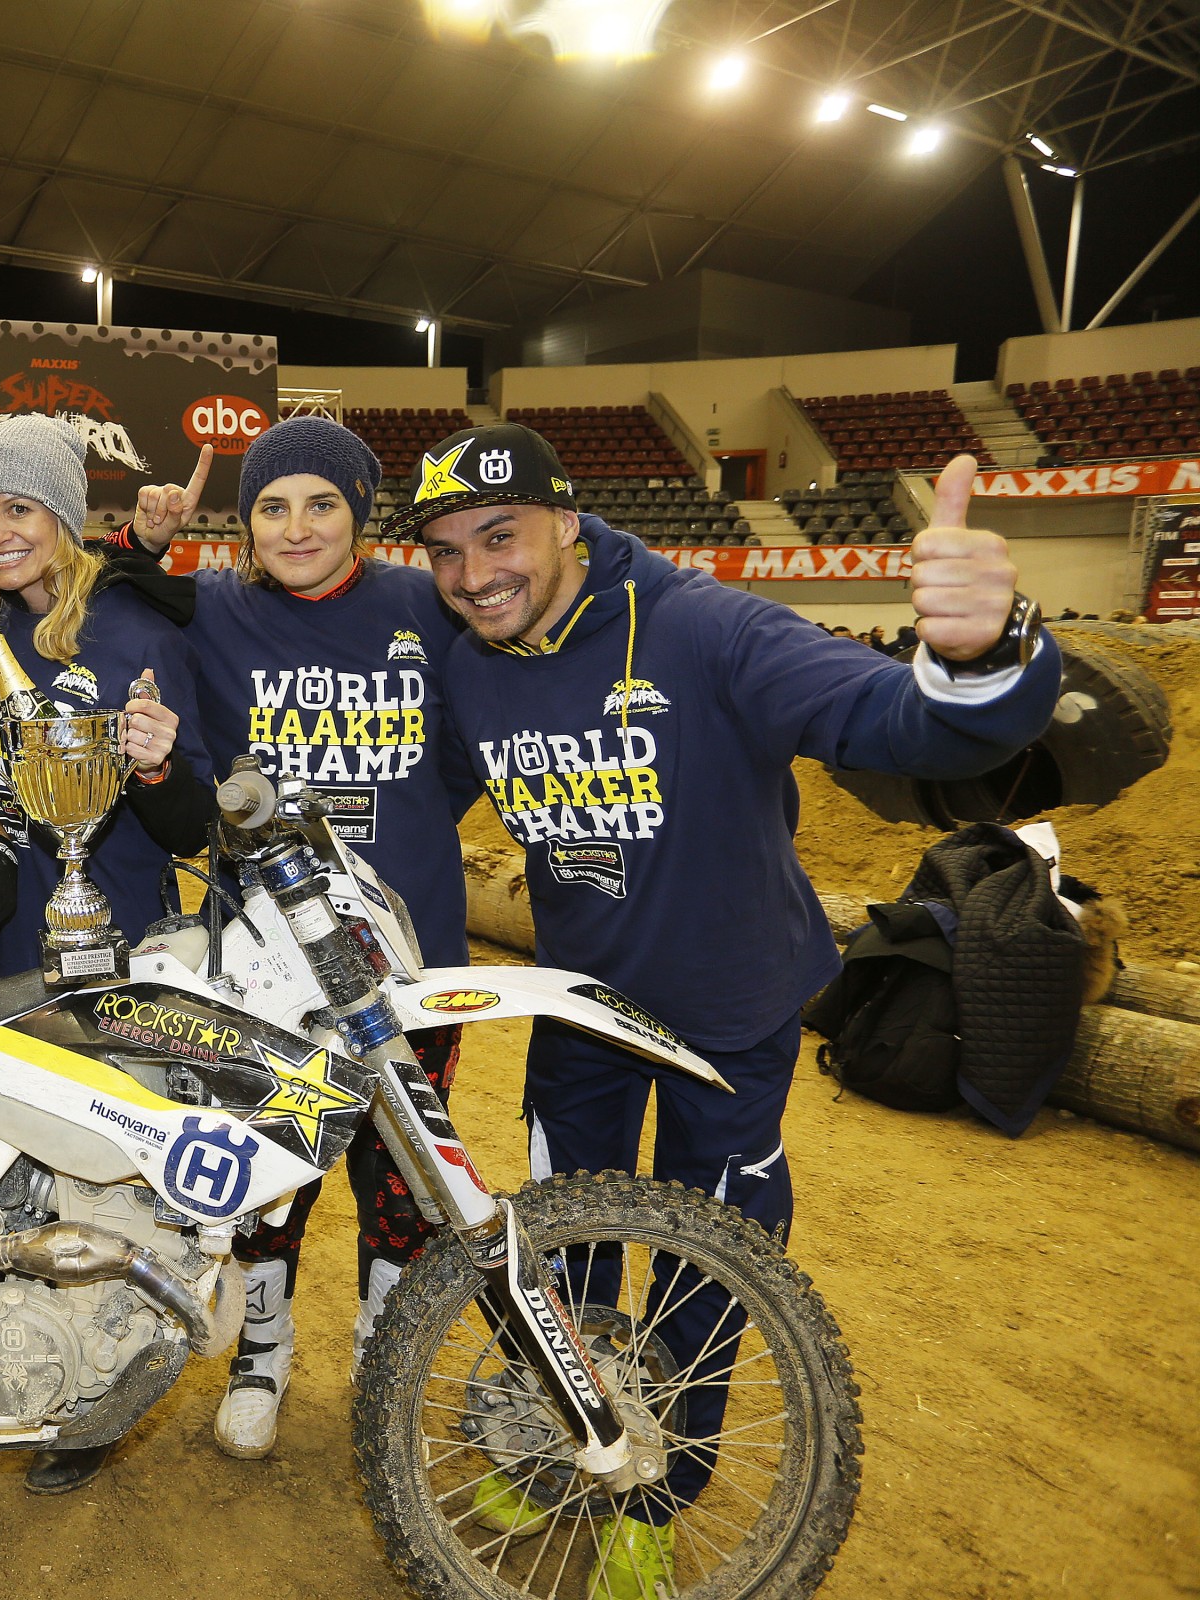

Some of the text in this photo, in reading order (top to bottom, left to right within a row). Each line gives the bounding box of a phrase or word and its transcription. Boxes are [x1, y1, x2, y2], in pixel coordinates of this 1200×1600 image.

[31, 358, 79, 370] MAXXIS
[191, 399, 262, 436] abc
[210, 437, 245, 449] com
[387, 640, 427, 661] ENDURO
[394, 630, 421, 644] SUPER
[51, 669, 100, 702] ENDURO
[68, 663, 98, 682] SUPER
[249, 706, 426, 746] HAAKER
[249, 742, 424, 782] CHAMP
[485, 767, 663, 813] HAAKER
[332, 825, 369, 835] qvarna
[502, 802, 665, 844] CHAMP
[568, 850, 617, 861] ROCKSTAR
[573, 870, 621, 889] Husqvarna
[422, 991, 499, 1010] FMF
[96, 992, 242, 1057] ROCKSTAR
[100, 1017, 220, 1064] ENERGY DRINK
[89, 1099, 167, 1143] Husqvarna
[124, 1132, 164, 1151] FACTORY RACING
[522, 1287, 600, 1409] DUNLOP
